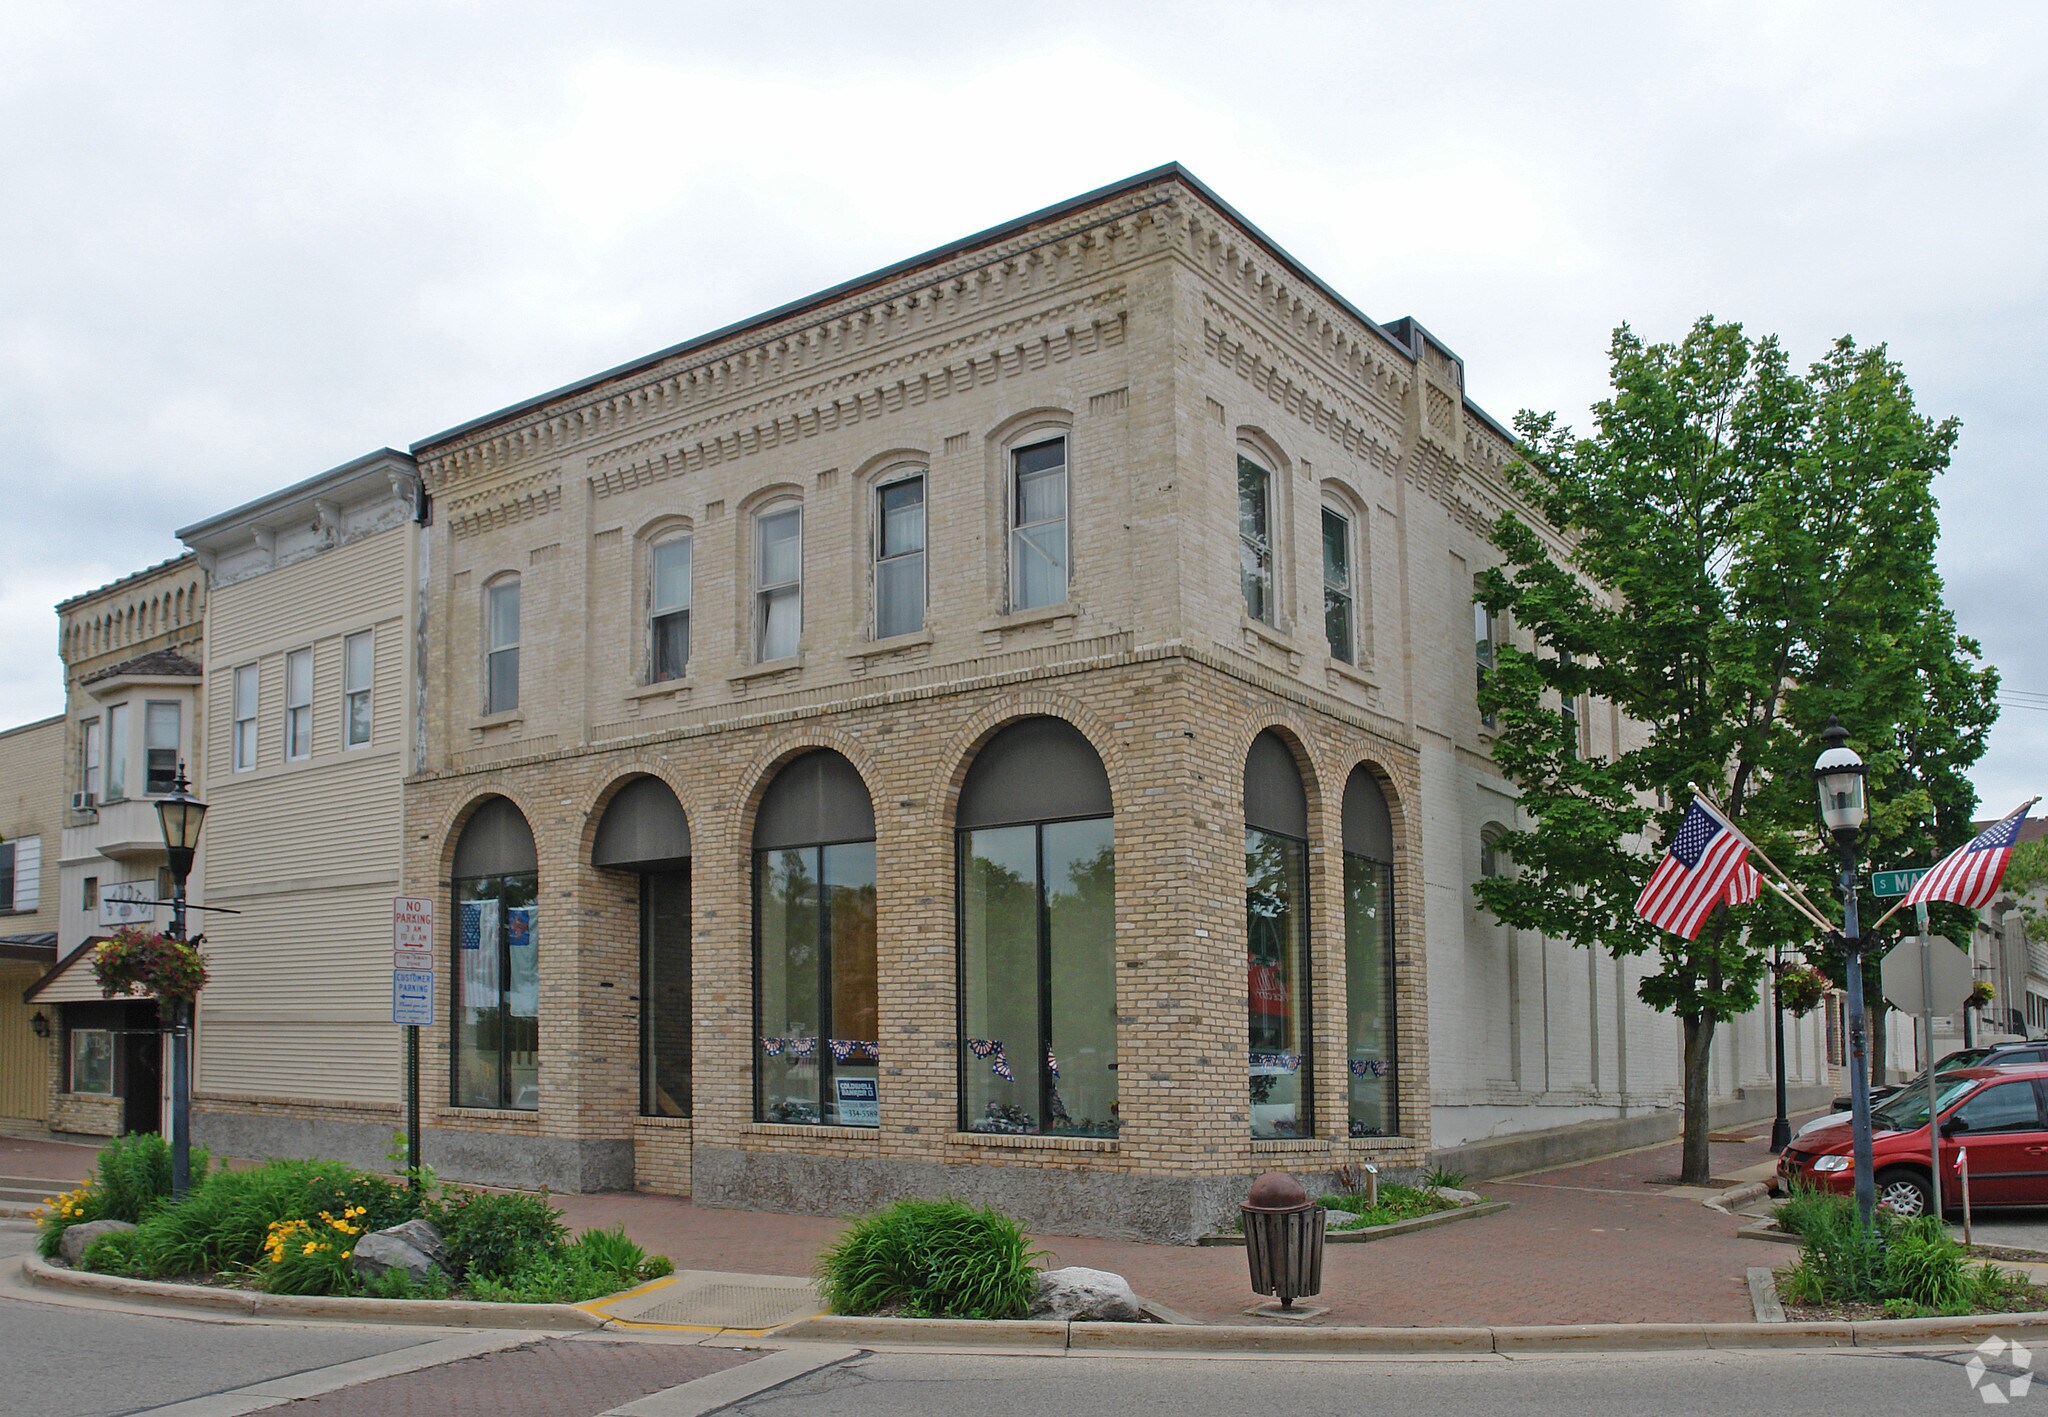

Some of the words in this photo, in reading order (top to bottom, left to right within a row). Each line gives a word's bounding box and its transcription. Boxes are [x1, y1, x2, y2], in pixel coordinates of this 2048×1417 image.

[1880, 879, 1886, 889] S
[406, 901, 421, 912] NO
[396, 913, 431, 924] PARKING
[396, 973, 431, 983] CUSTOMER
[398, 984, 428, 993] PARKING
